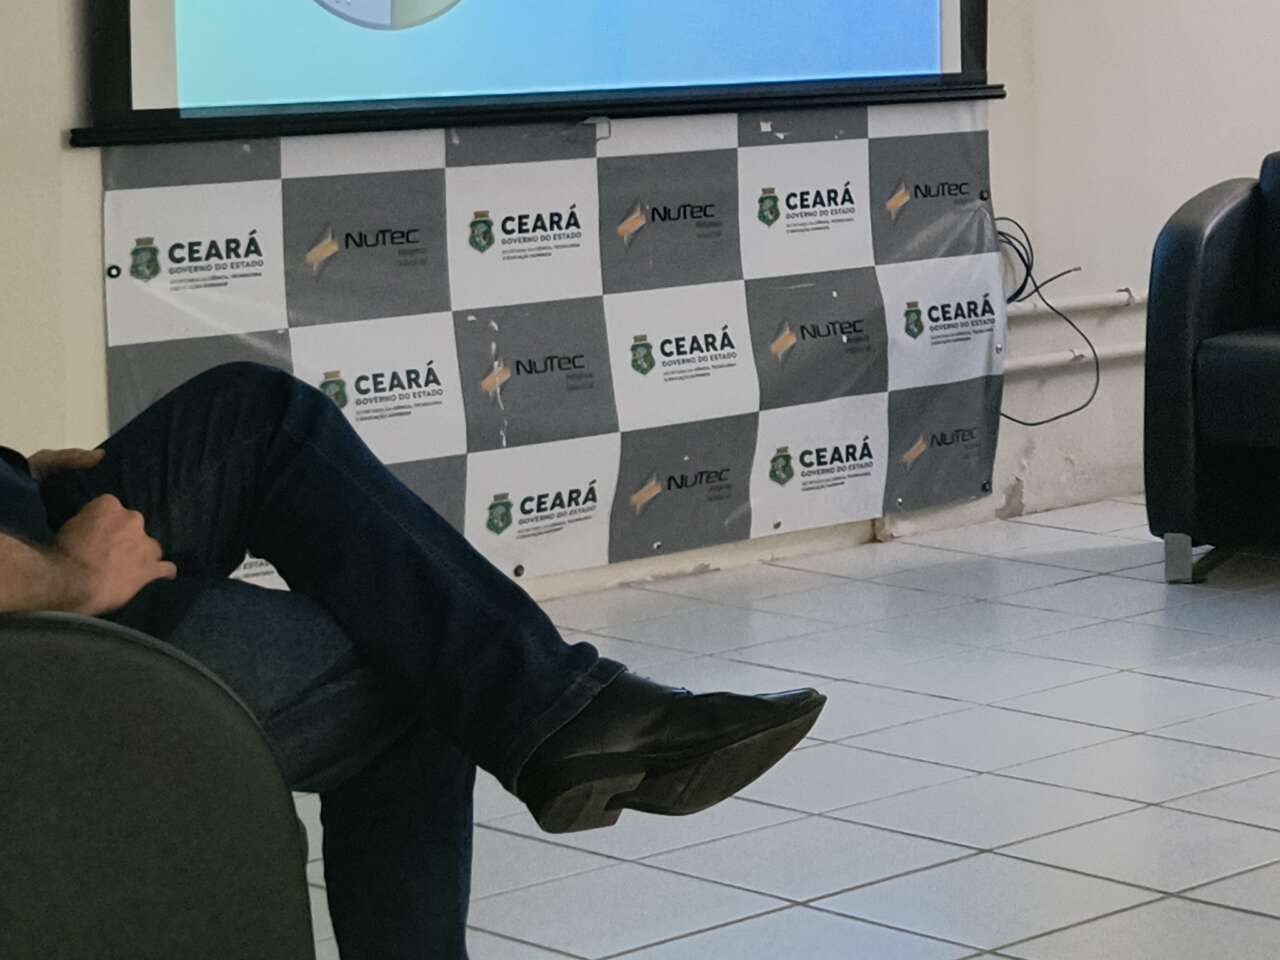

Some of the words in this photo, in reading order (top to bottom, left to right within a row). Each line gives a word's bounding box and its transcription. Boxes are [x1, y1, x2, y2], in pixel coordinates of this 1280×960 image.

[785, 180, 855, 210] CEARÁ
[501, 203, 582, 235] CEARÁ
[168, 229, 263, 263] CEARÁ
[927, 292, 995, 323] CEARÁ
[660, 324, 735, 357] CEARÁ
[354, 360, 441, 395] CEARÁ
[799, 434, 873, 468] CEARÁ
[520, 479, 597, 515] CEARÁ
